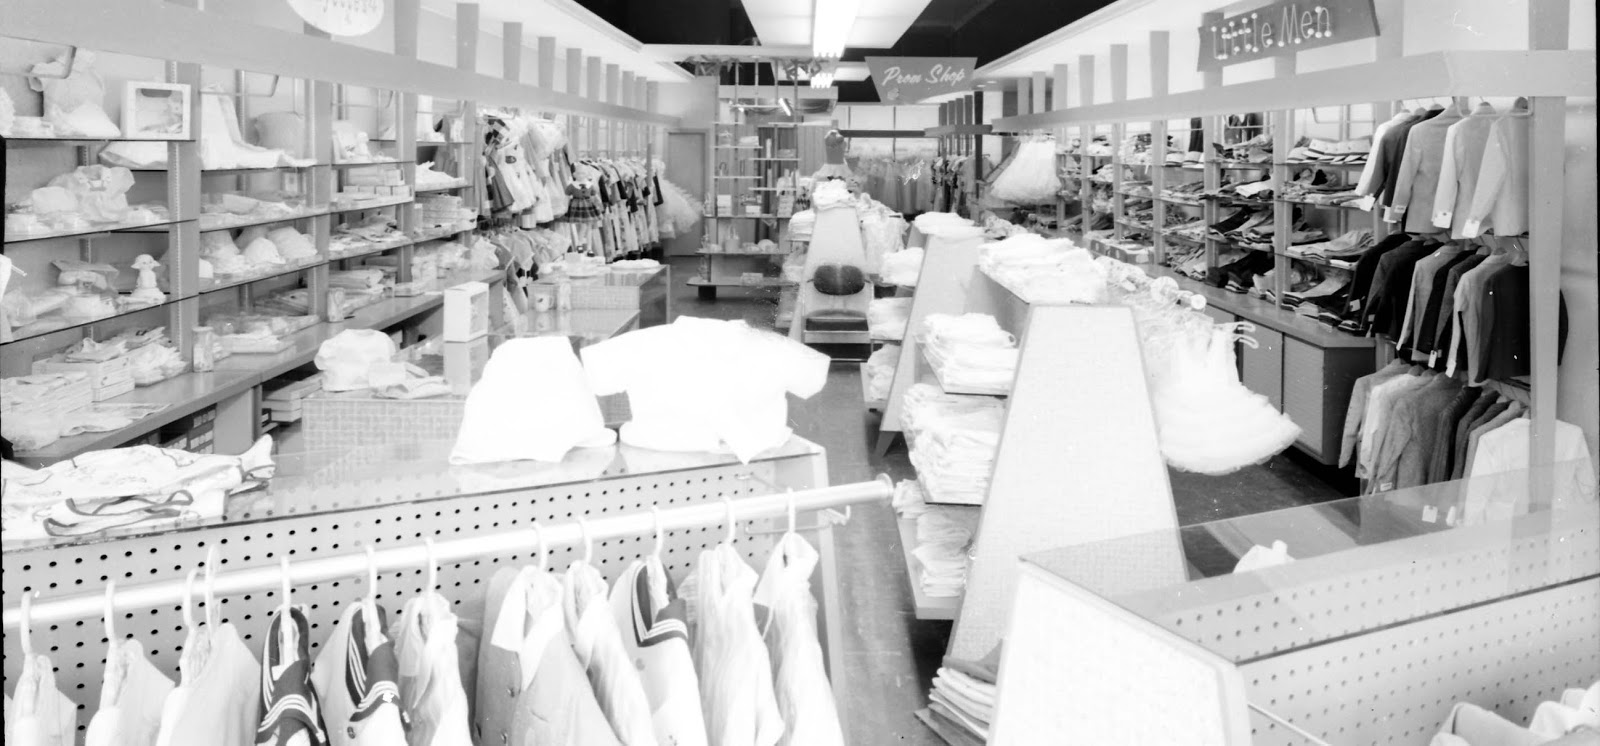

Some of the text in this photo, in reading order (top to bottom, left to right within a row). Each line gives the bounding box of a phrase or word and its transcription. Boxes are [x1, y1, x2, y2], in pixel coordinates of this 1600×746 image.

[1211, 4, 1332, 60] Little Men
[881, 63, 965, 87] Prom Shop
